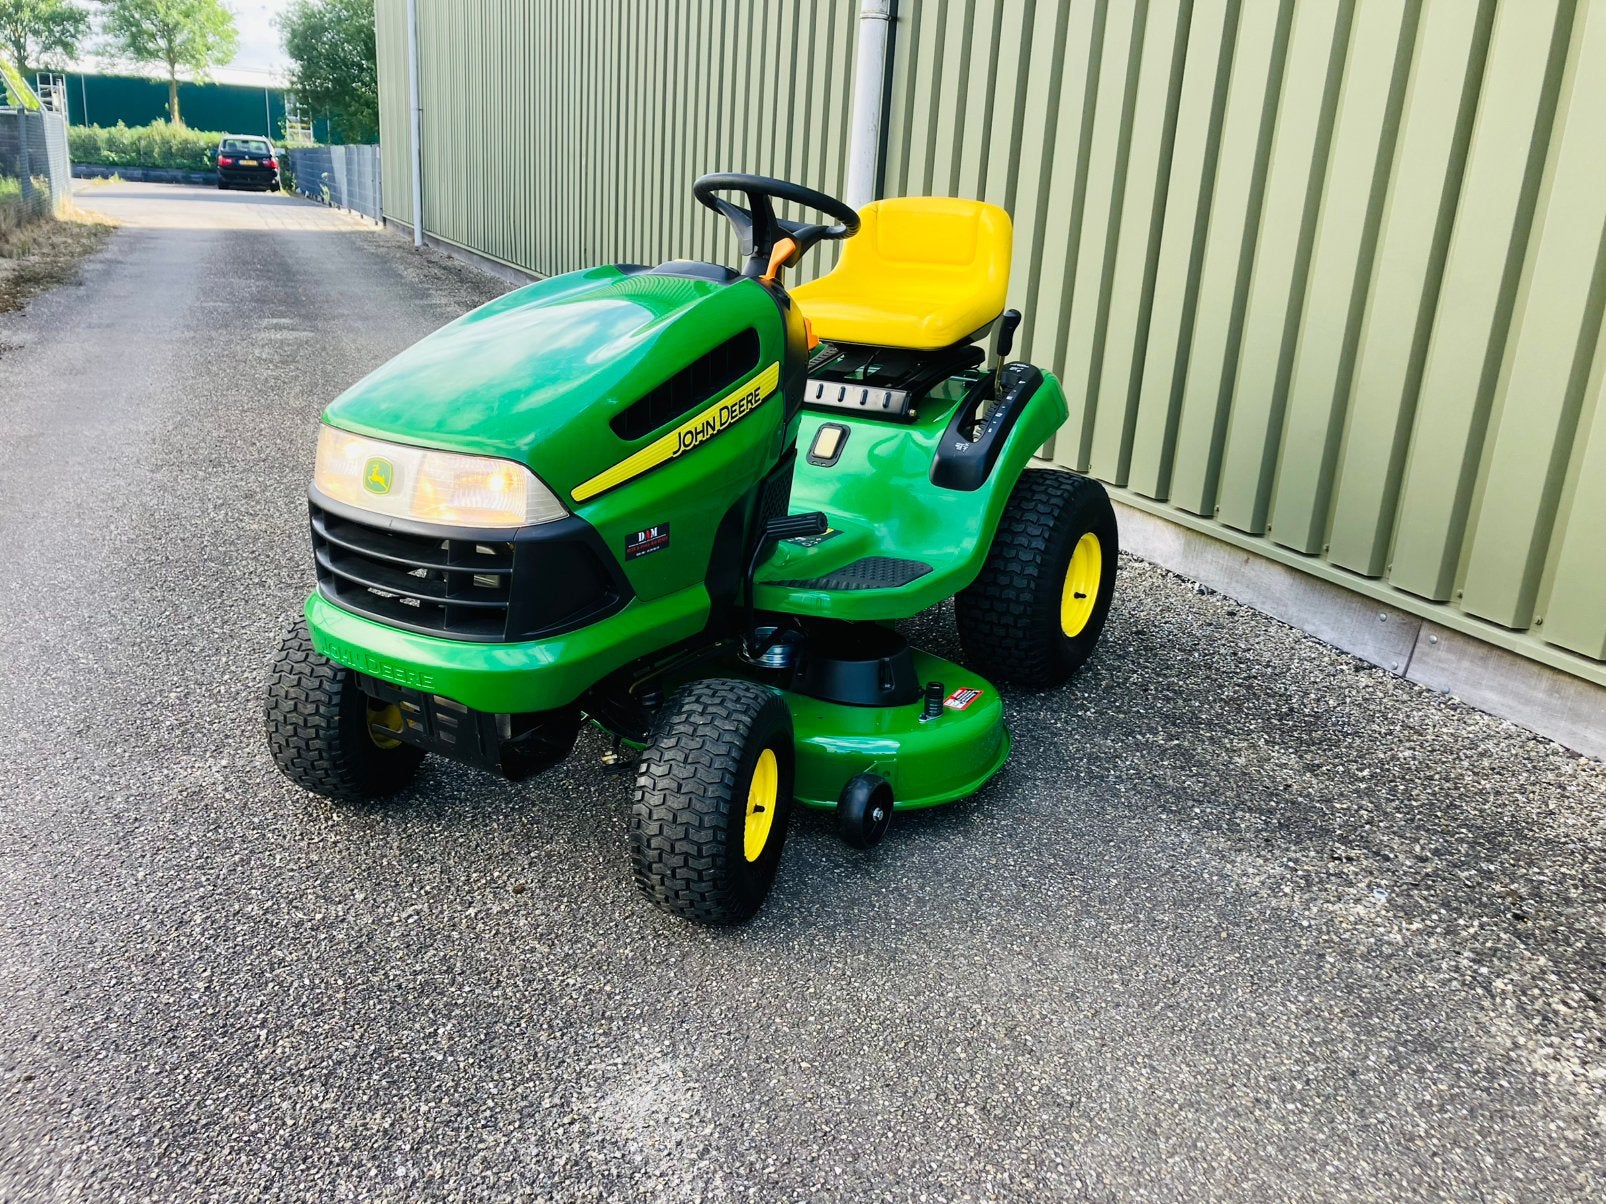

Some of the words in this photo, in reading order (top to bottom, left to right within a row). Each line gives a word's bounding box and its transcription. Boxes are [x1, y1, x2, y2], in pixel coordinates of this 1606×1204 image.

[672, 416, 717, 457] JOHN
[718, 386, 762, 426] DEERE
[366, 657, 436, 690] DEERE
